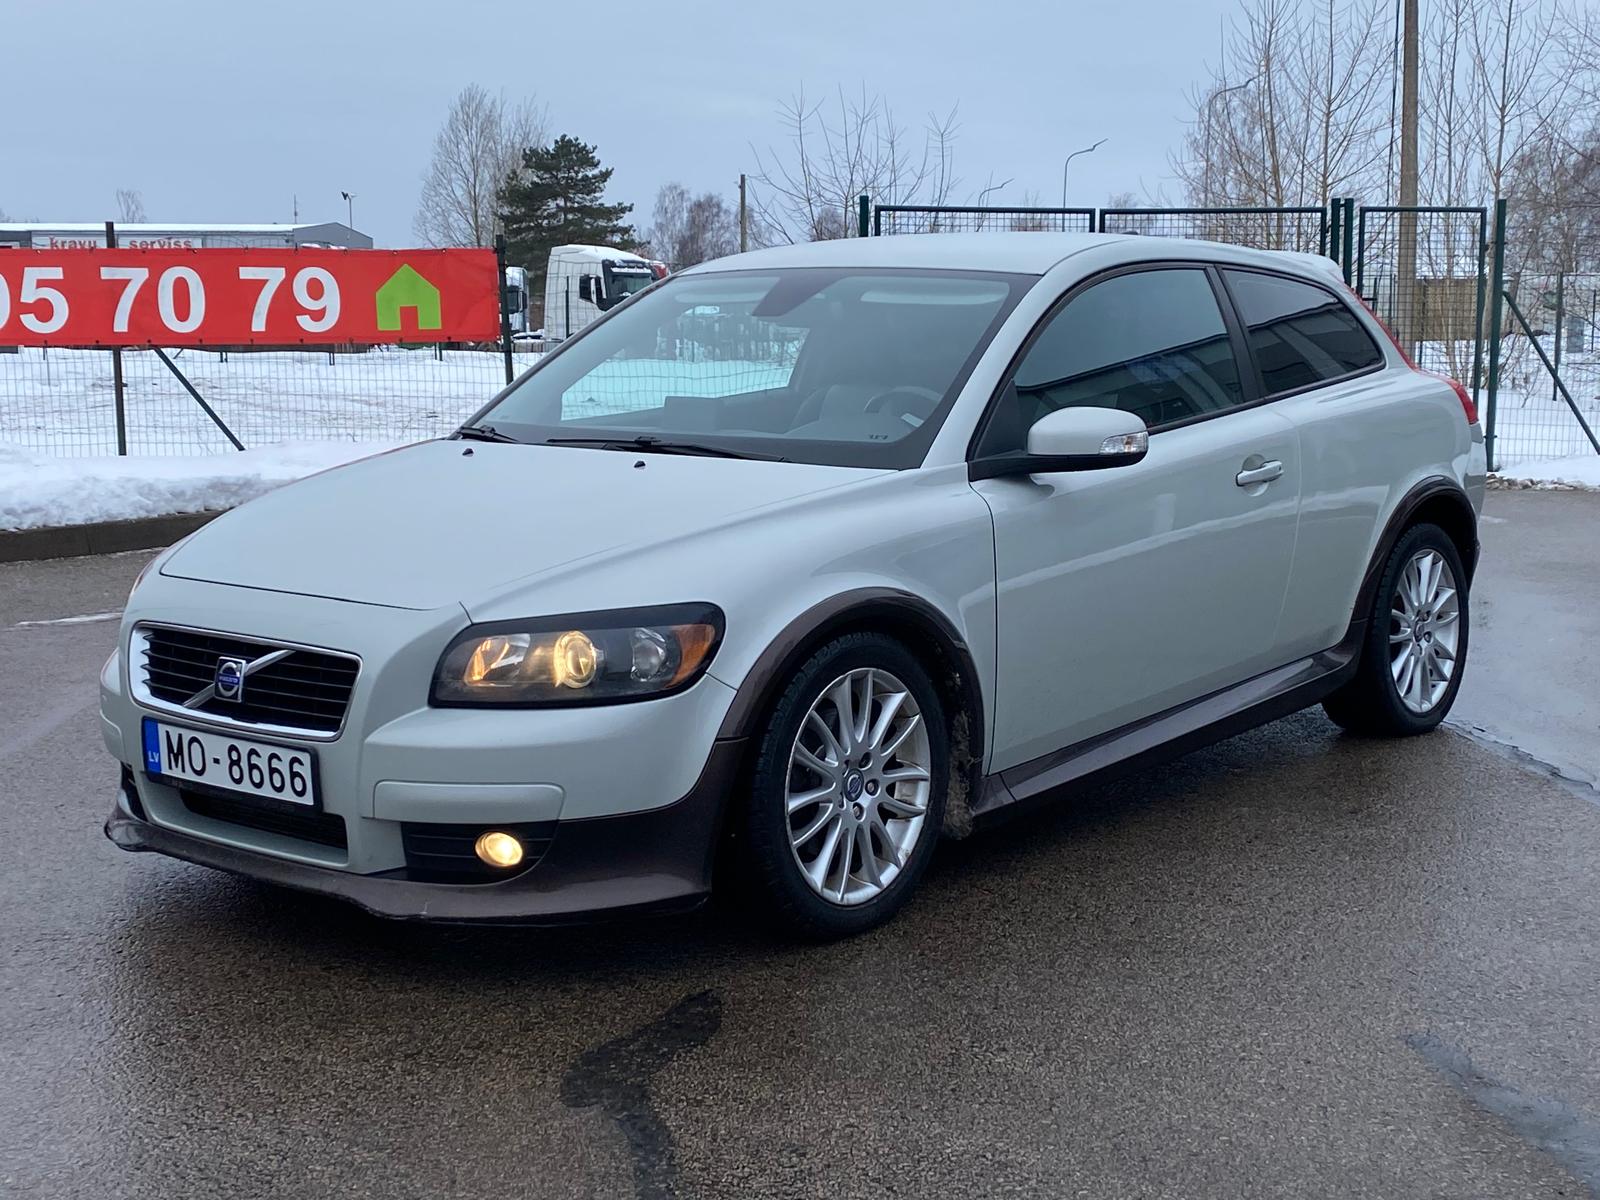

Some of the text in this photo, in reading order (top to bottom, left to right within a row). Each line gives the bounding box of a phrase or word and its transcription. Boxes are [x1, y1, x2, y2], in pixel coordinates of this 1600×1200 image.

[129, 239, 193, 249] serviss
[0, 266, 340, 333] 5 70 79
[149, 751, 160, 763] LV
[165, 730, 307, 798] MO-8666
